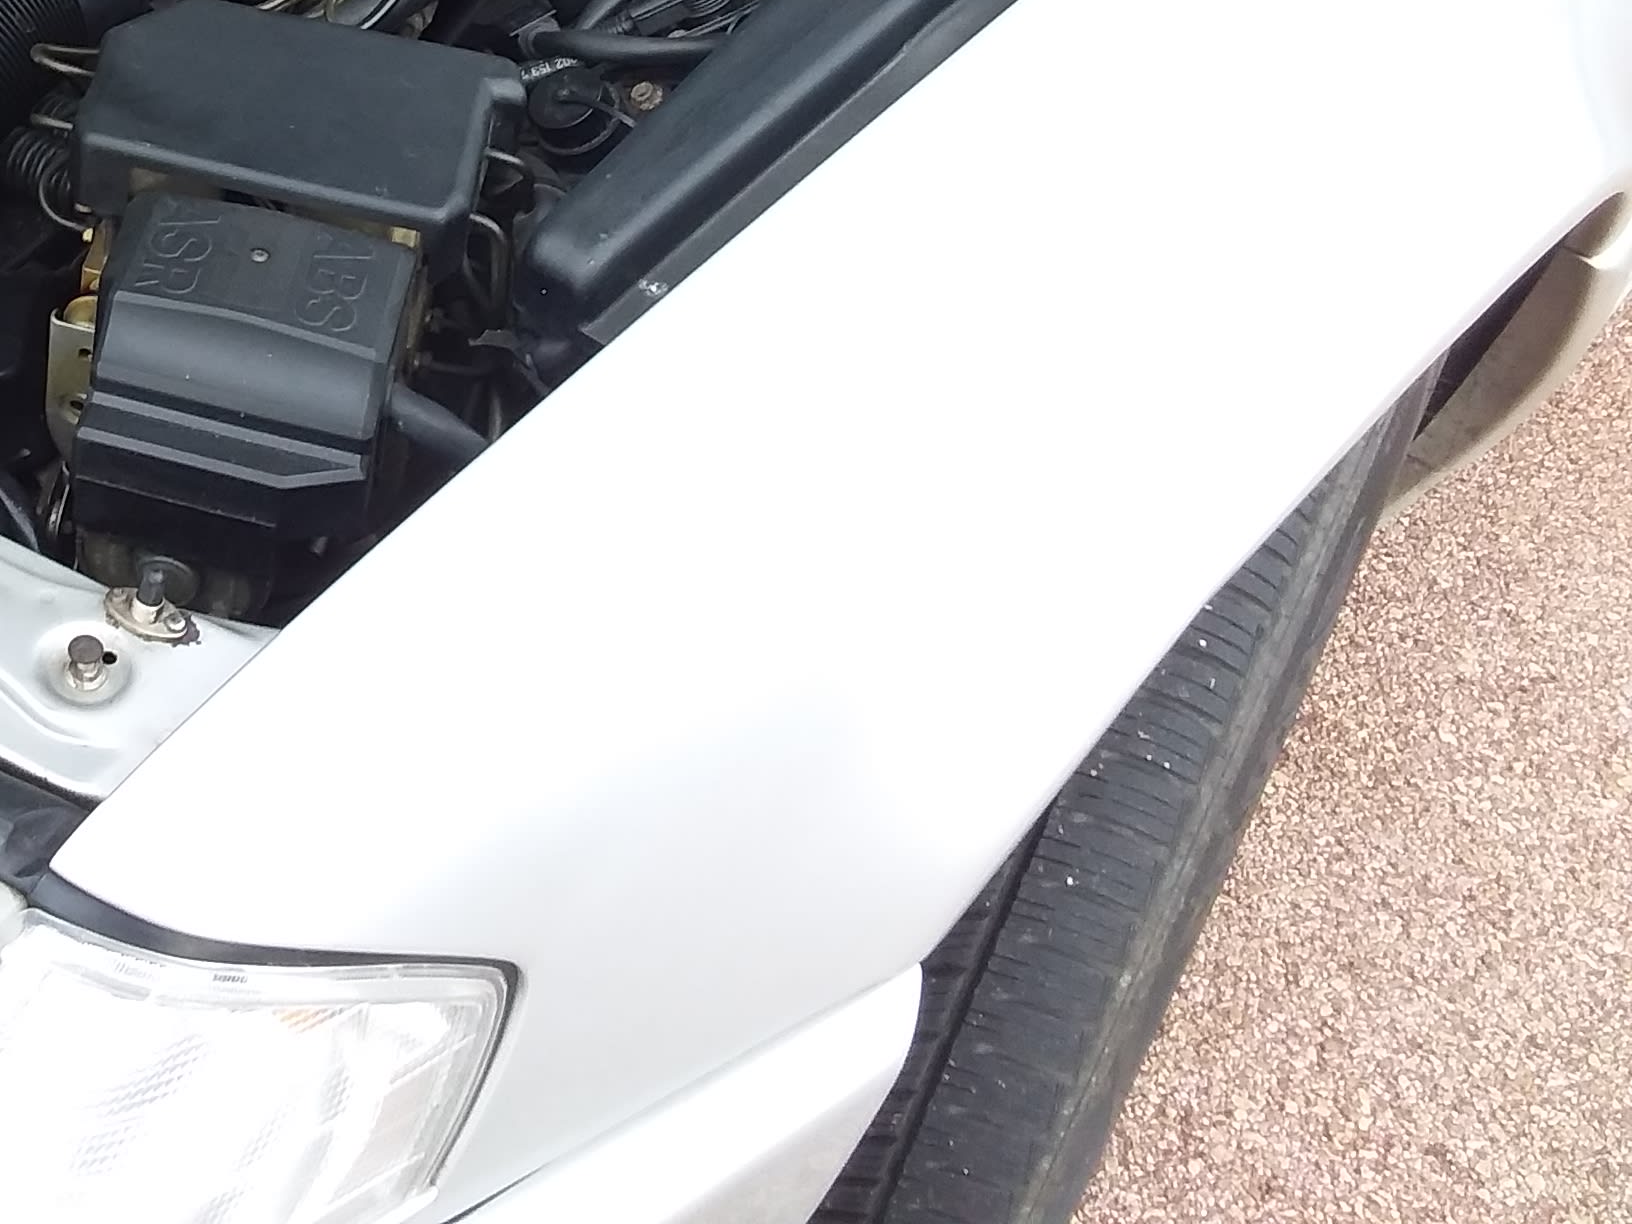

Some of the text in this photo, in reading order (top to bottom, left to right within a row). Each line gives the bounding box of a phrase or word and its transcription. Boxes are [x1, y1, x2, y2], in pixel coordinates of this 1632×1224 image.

[531, 61, 552, 77] 153
[135, 196, 223, 295] ASR
[294, 232, 376, 333] ABS
